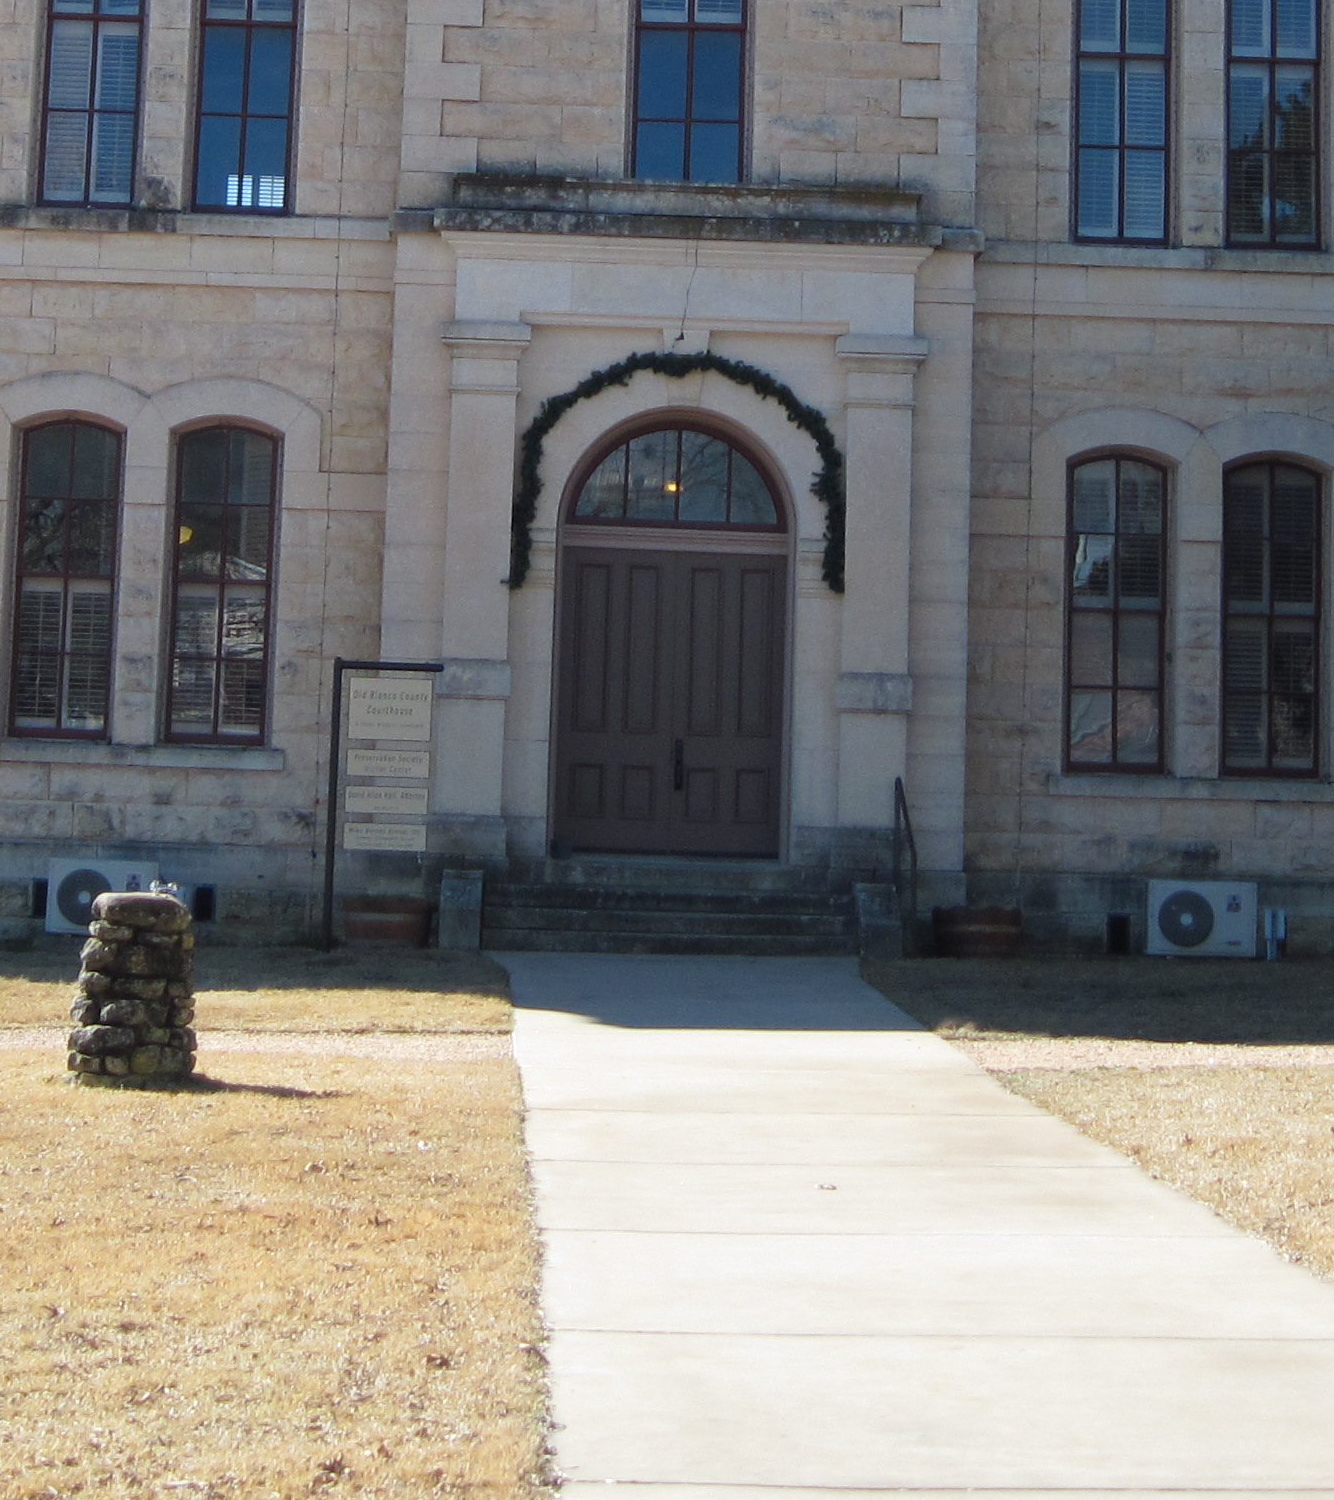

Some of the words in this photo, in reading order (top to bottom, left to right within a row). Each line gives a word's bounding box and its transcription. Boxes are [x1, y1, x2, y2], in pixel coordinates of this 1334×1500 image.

[353, 689, 367, 699] Old
[370, 690, 397, 701] Blanco
[400, 691, 429, 702] County
[366, 704, 413, 716] Courthouse
